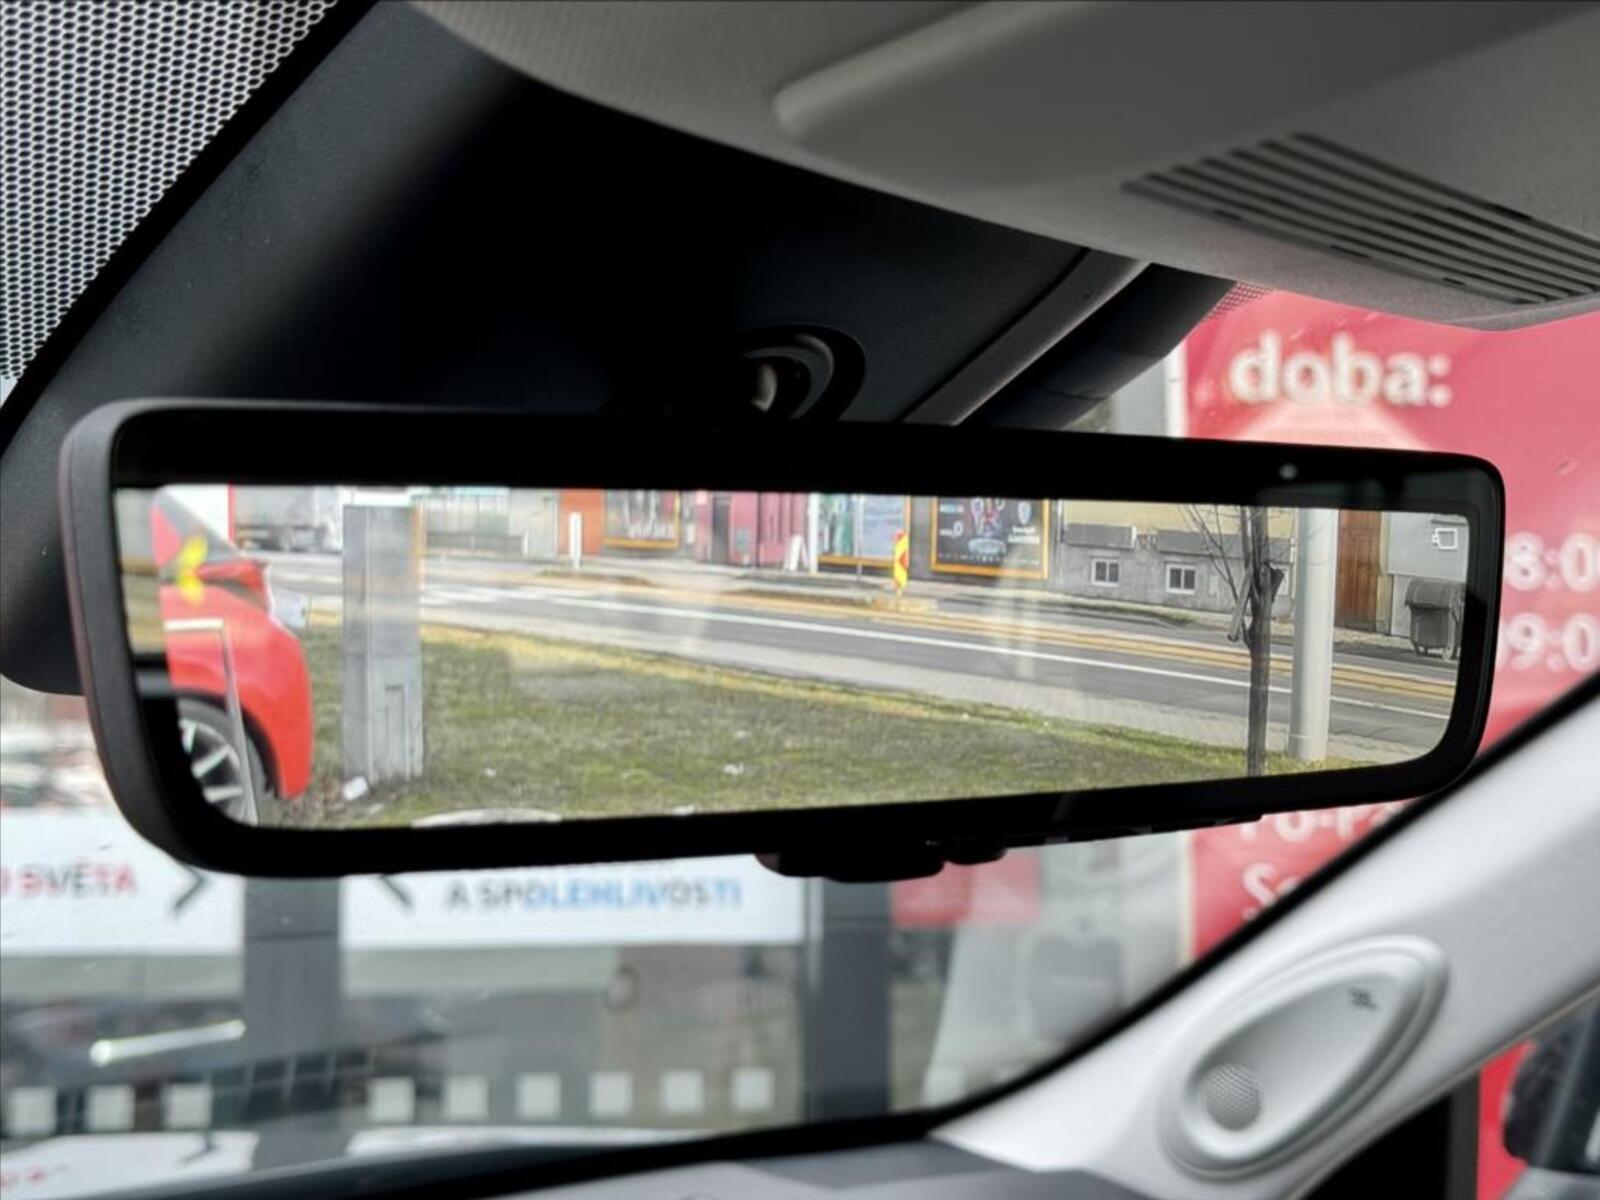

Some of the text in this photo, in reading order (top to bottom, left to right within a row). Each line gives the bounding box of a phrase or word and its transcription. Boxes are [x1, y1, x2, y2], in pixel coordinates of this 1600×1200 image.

[1229, 332, 1453, 407] doba:
[1503, 531, 1600, 592] 8:0
[1497, 612, 1600, 671] 9:0
